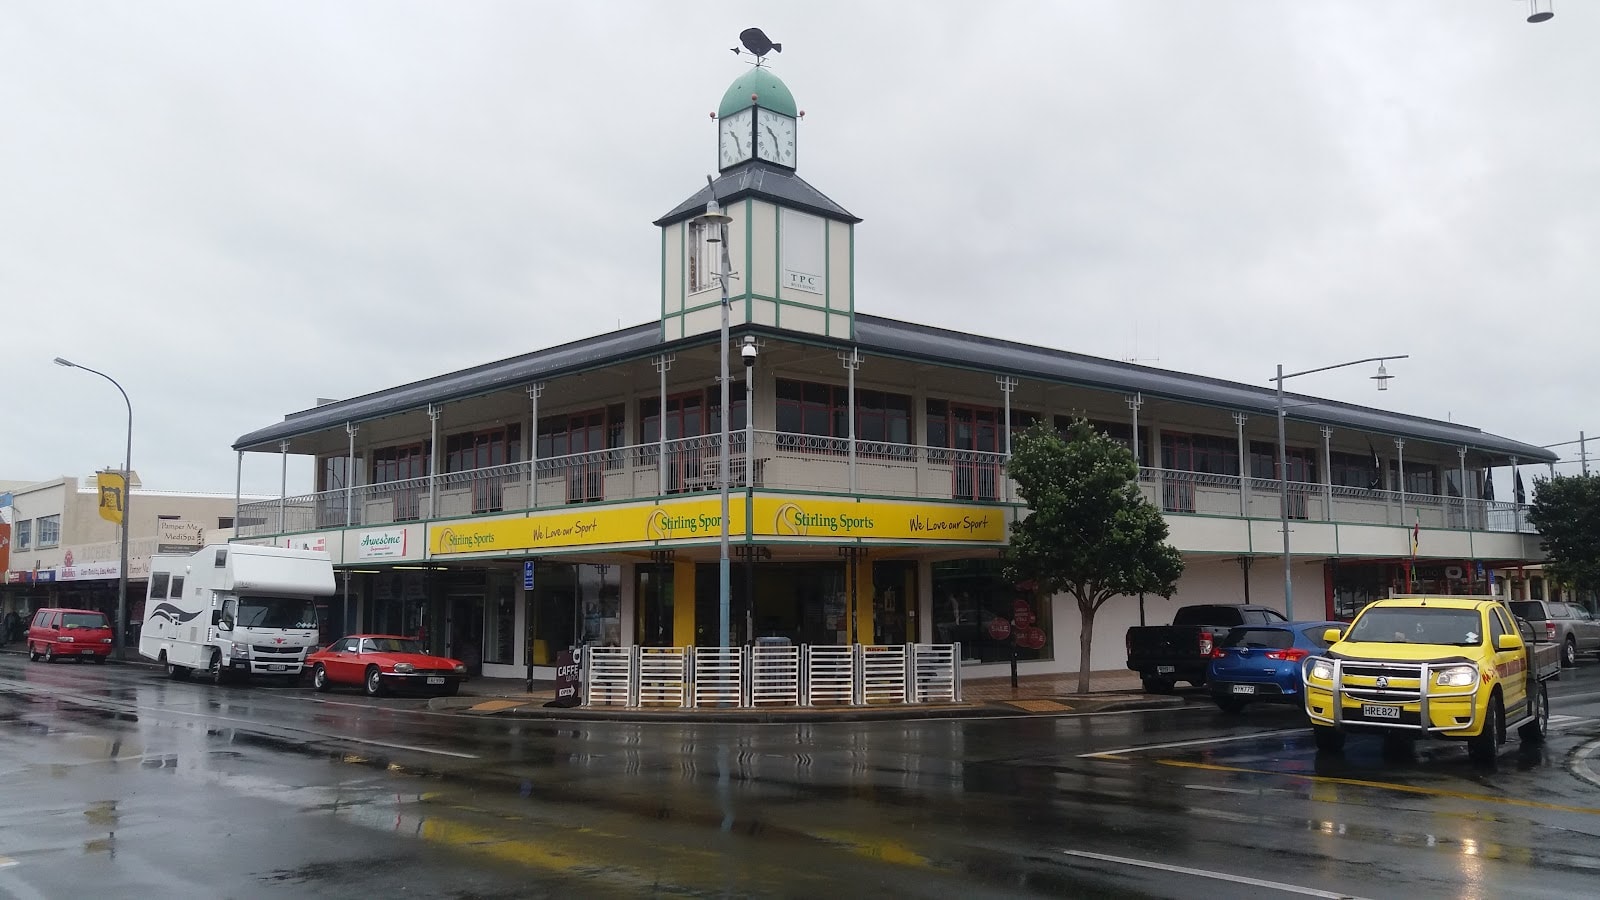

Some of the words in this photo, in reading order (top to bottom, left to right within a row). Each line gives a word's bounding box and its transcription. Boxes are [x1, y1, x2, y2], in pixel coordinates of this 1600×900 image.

[161, 522, 185, 531] Pamper
[187, 523, 198, 531] Me
[661, 515, 696, 533] Stirling
[794, 512, 838, 532] Stirling
[839, 513, 874, 532] Sports
[909, 513, 925, 532] We
[926, 516, 948, 532] Love
[948, 520, 962, 530] our
[963, 514, 989, 534] Sport
[165, 532, 196, 542] MediSpa
[533, 524, 545, 542] We
[545, 525, 562, 540] Love
[562, 526, 573, 537] our
[575, 518, 598, 538] Sport
[360, 532, 401, 547] Awesome
[449, 534, 473, 548] Stirling
[473, 532, 495, 547] Sports
[557, 664, 579, 677] CAFFE
[561, 688, 572, 696] OPEN
[1365, 706, 1399, 717] HRE827
